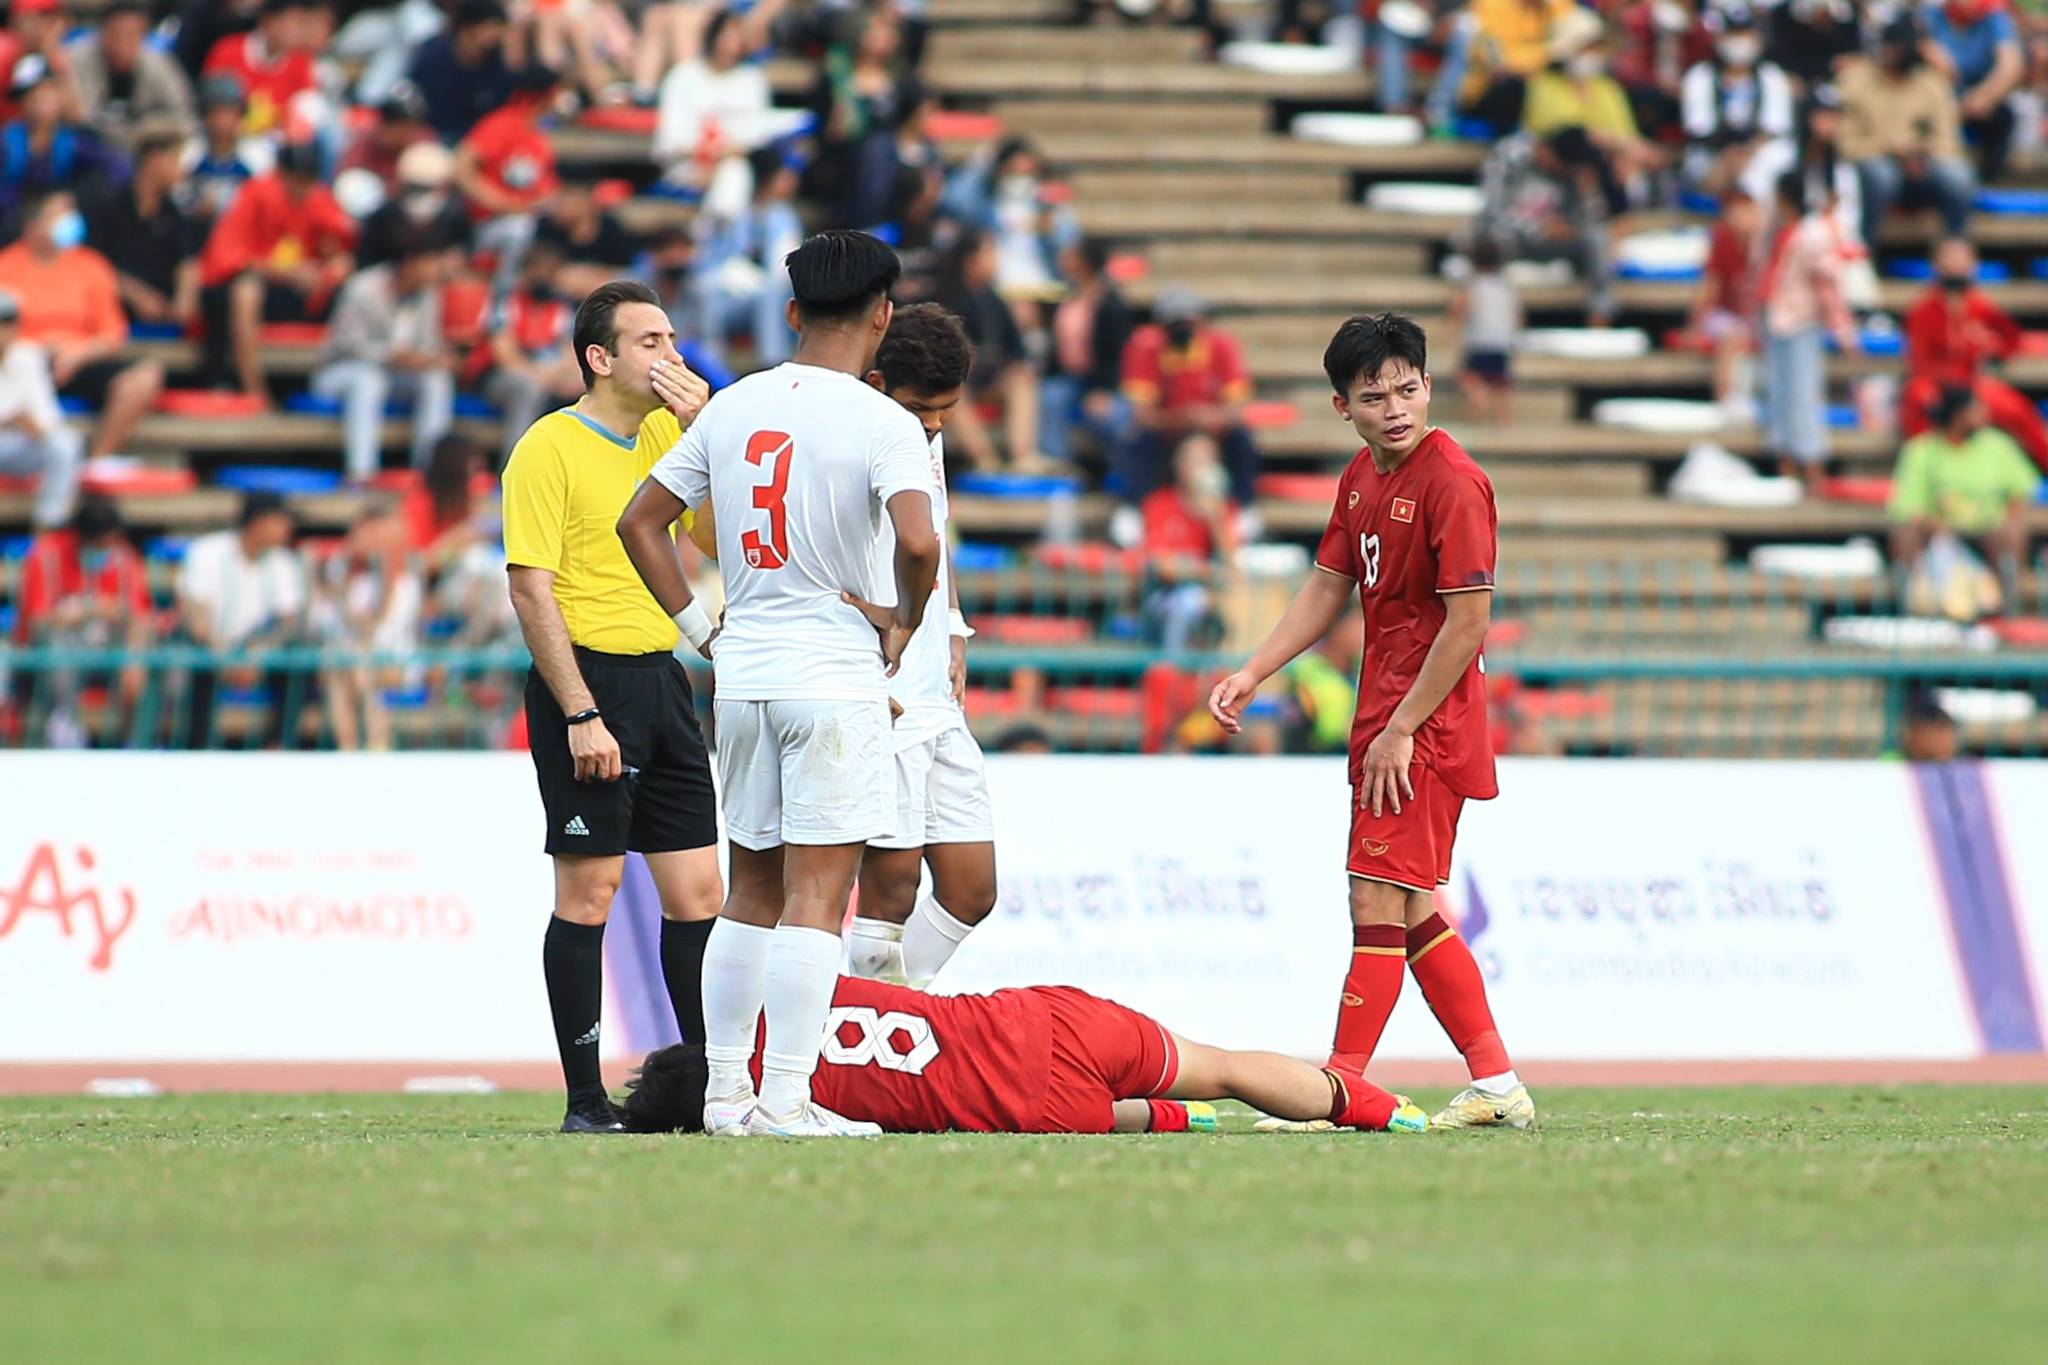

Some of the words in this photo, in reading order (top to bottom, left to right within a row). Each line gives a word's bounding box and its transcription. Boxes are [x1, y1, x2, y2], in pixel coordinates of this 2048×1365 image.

[741, 428, 794, 569] 3
[169, 895, 471, 946] AJINOMOTO
[820, 1006, 940, 1076] 8
